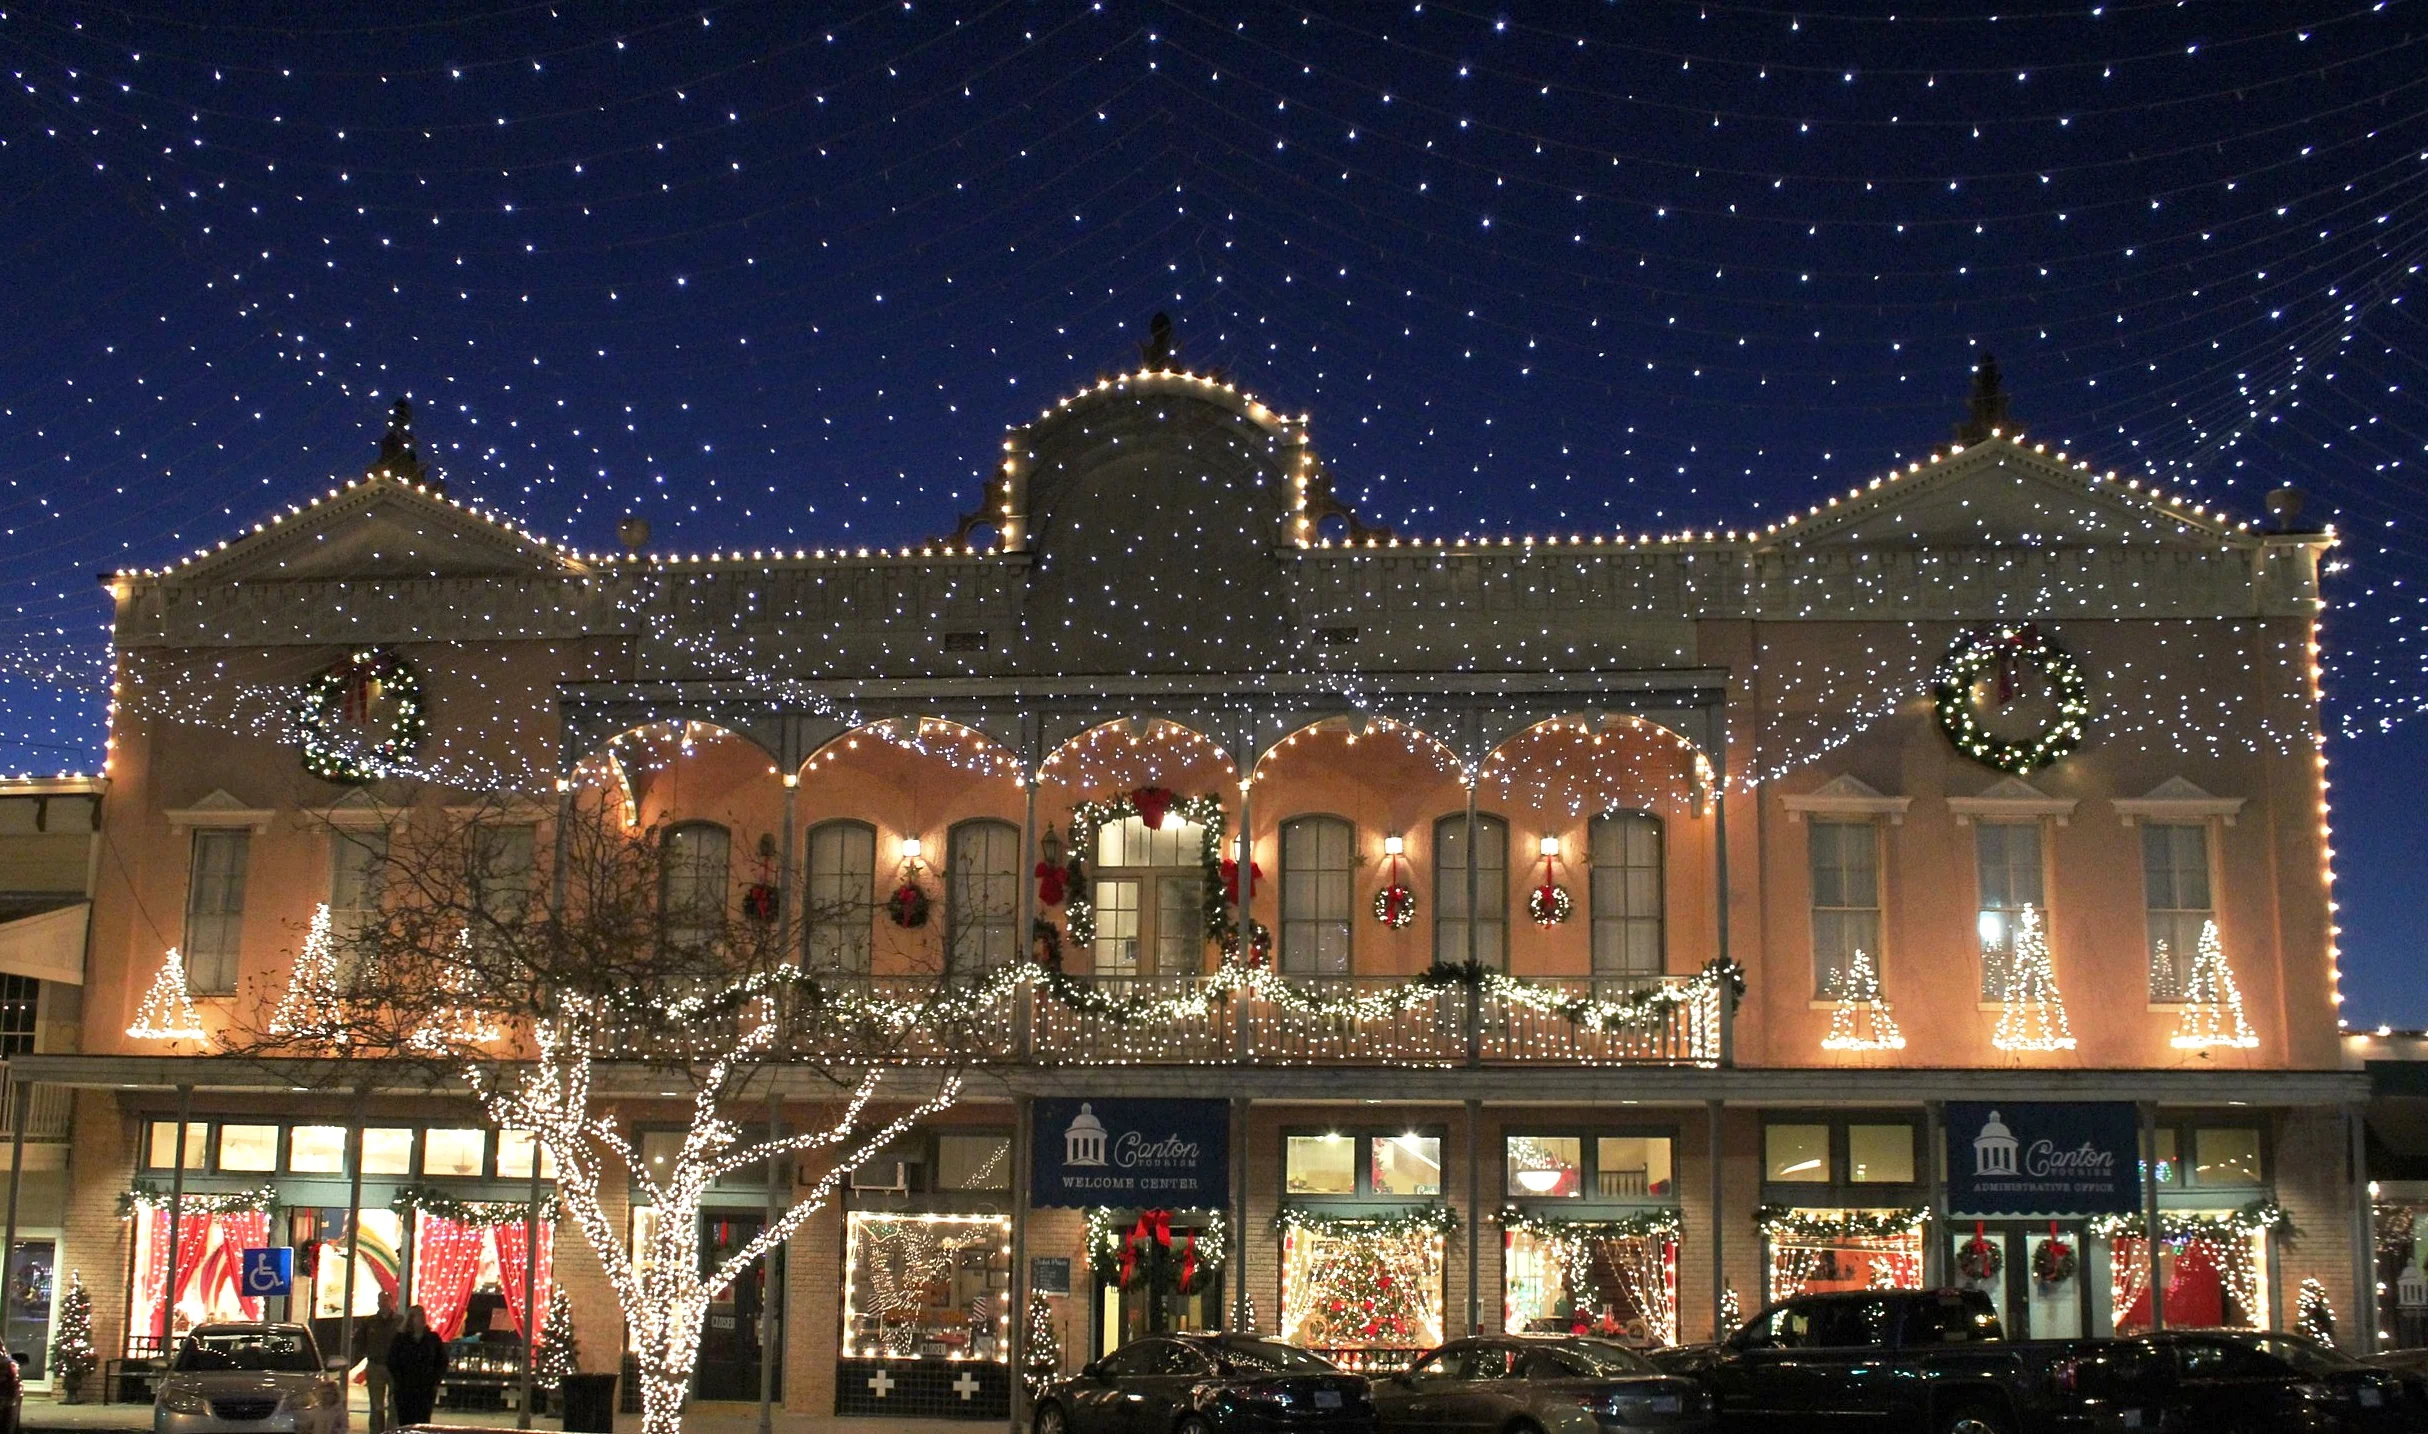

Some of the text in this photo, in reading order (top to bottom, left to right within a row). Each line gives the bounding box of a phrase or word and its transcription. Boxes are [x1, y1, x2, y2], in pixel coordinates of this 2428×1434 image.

[1114, 1130, 1201, 1168] Canton
[2026, 1139, 2115, 1177] Canton
[2050, 1169, 2112, 1177] TOURISM
[1062, 1176, 1199, 1190] WELCOME CENTER
[1973, 1182, 2115, 1192] ADMINISTRATIVE OFFICE
[711, 1315, 736, 1329] CLOSED
[920, 1342, 947, 1356] CLOSED
